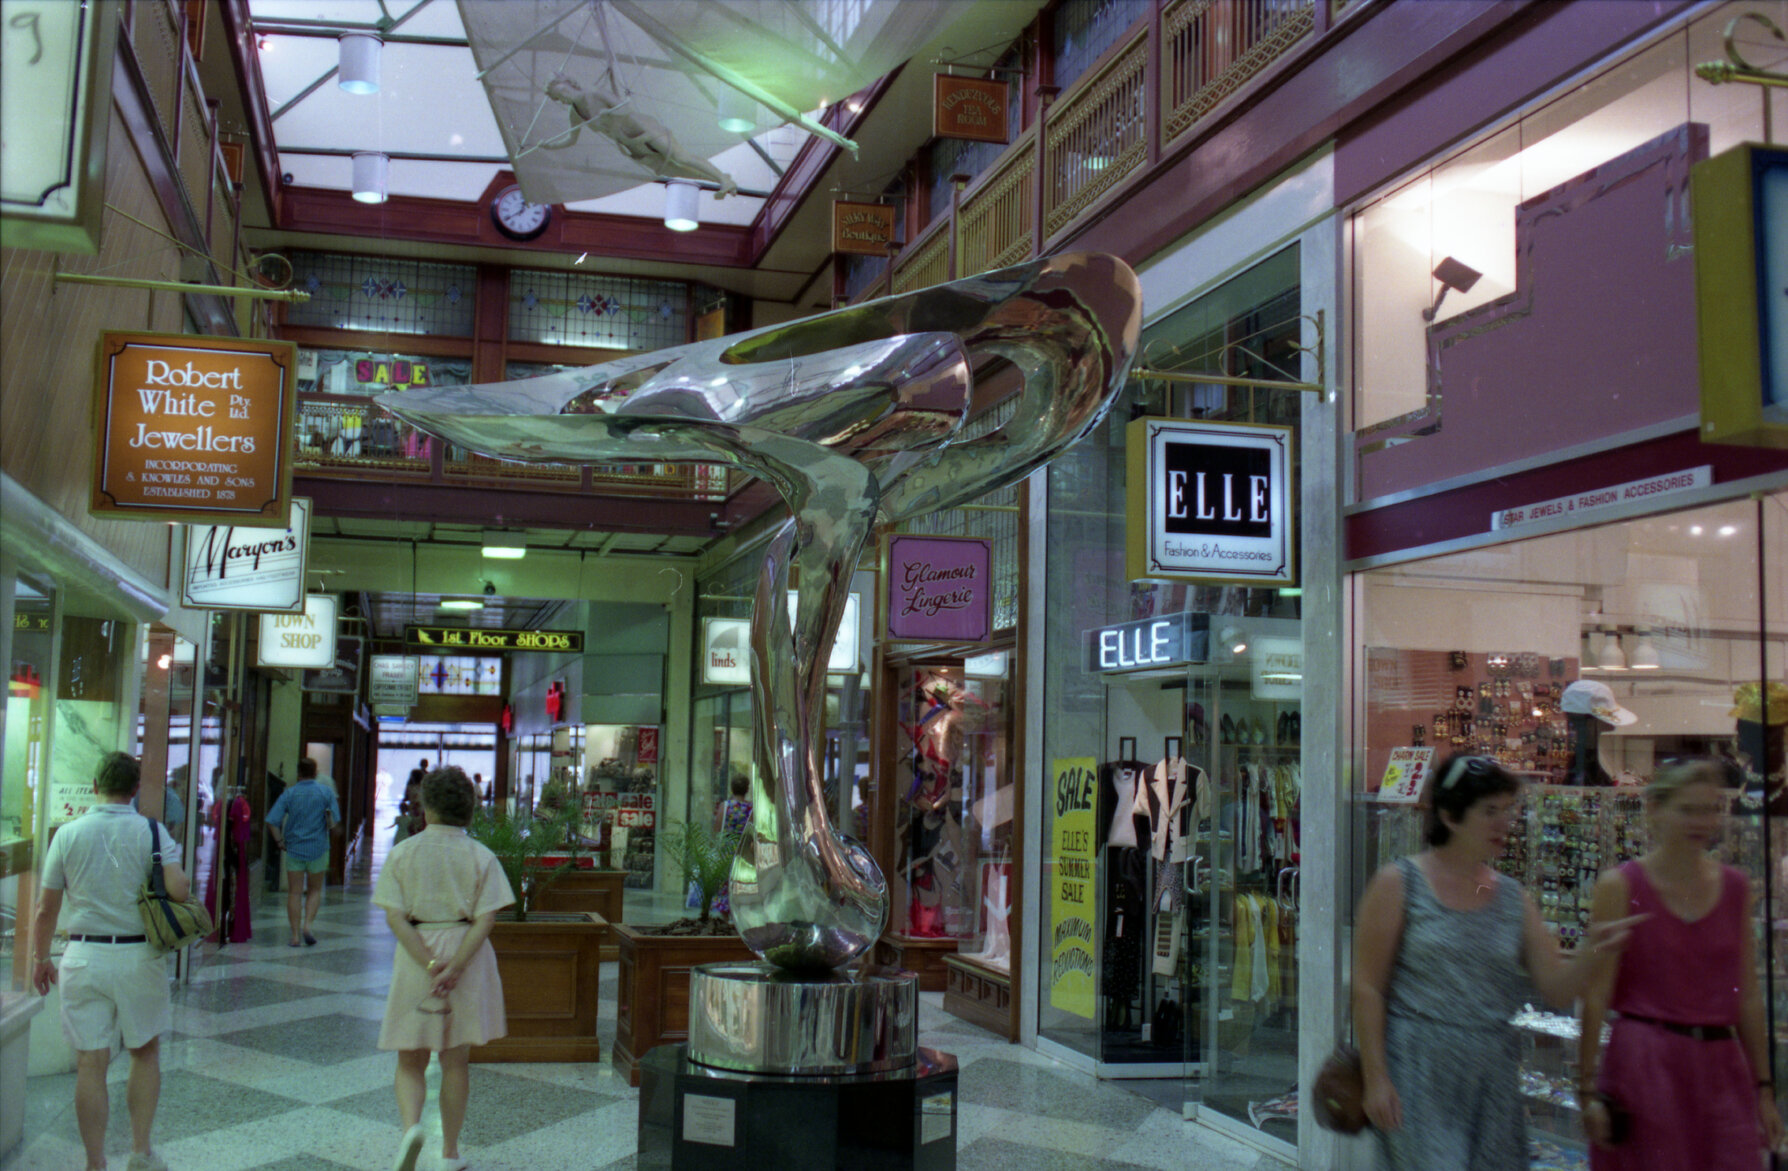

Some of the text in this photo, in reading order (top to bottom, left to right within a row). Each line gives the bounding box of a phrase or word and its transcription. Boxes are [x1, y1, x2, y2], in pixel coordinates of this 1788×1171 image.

[145, 360, 243, 390] Robert
[357, 360, 426, 385] SALE
[136, 388, 216, 417] White
[129, 423, 255, 453] Jewellers
[145, 459, 238, 474] INCORPORATING
[141, 472, 191, 485] KNOWLES
[196, 475, 220, 486] AND
[224, 476, 255, 487] SONS
[143, 486, 211, 499] ESTABLISHED
[1167, 470, 1268, 522] ELLE
[1529, 504, 1562, 519] JEWELS
[1568, 500, 1574, 511] &
[1578, 490, 1618, 509] FASHION
[1624, 473, 1694, 499] ACCESSORIES
[191, 525, 296, 584] Maryon's
[1164, 540, 1272, 561] Fashion & Accessories
[901, 562, 975, 592] Glamour
[901, 586, 972, 617] Lingerie
[272, 614, 316, 629] TOWN
[280, 632, 322, 649] SHOP
[468, 630, 508, 646] Floor
[516, 632, 570, 649] SHOPS
[1100, 621, 1171, 668] ELLE
[711, 651, 736, 668] linds
[621, 793, 654, 809] sale
[1056, 766, 1096, 818] SALE
[620, 811, 654, 827] sale
[1061, 829, 1089, 852] ELLE'S
[1059, 856, 1090, 879] SUMMER
[1061, 882, 1084, 904] SALE
[1054, 917, 1092, 949] MAXIMUM
[1053, 947, 1094, 986] REDUCTIONS
